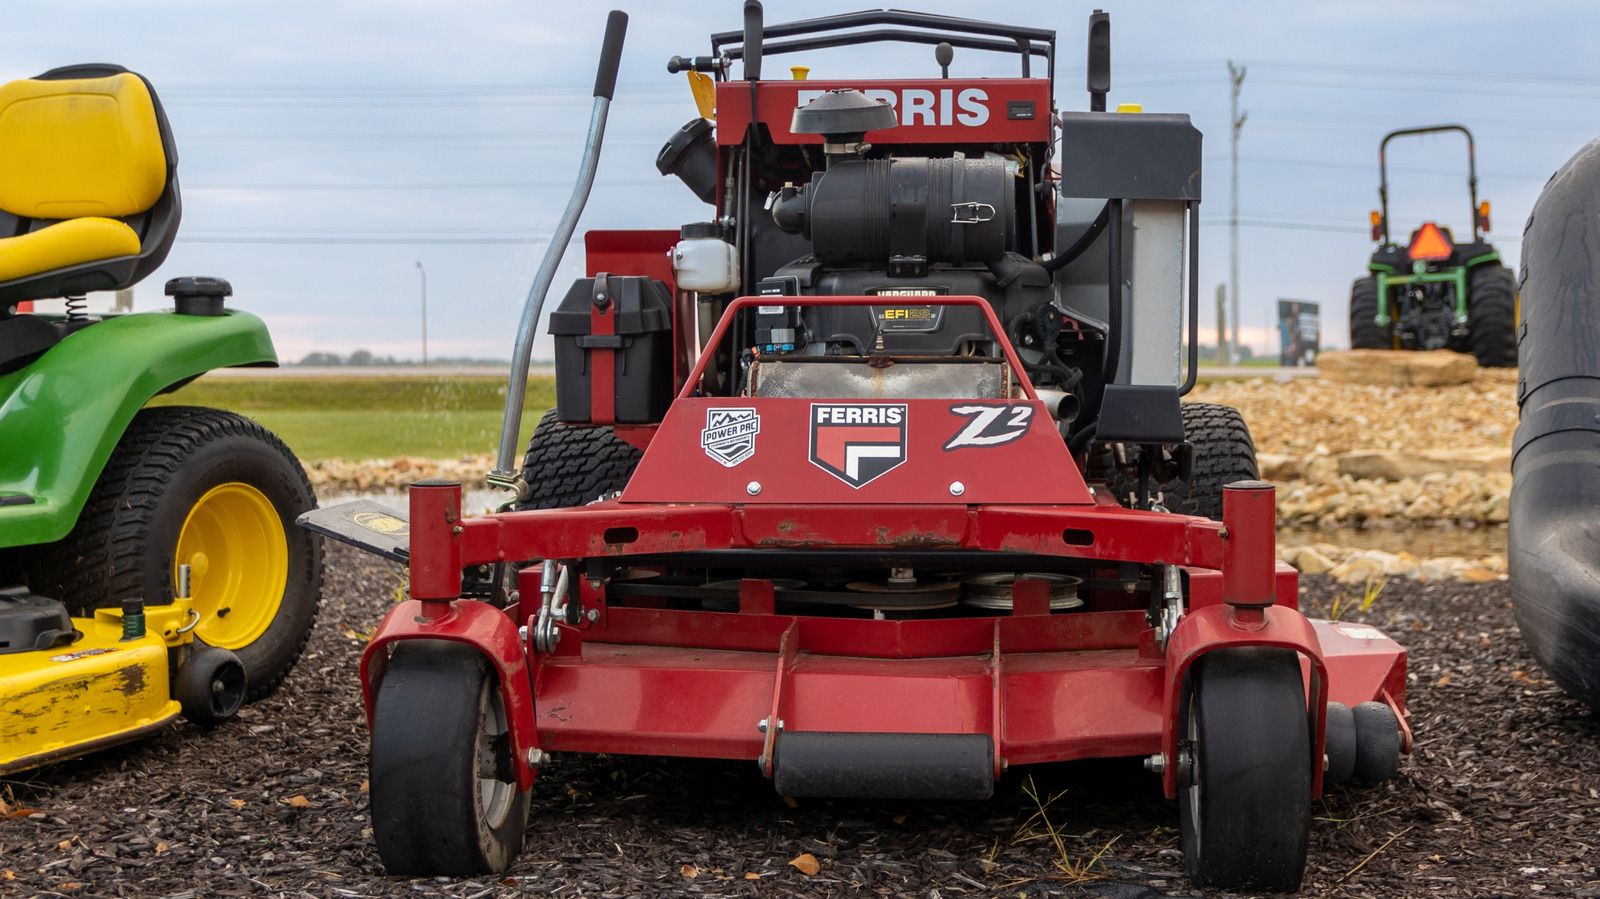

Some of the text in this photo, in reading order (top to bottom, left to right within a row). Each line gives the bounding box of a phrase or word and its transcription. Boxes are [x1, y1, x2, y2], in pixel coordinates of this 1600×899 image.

[797, 88, 990, 127] RIS
[817, 407, 902, 424] FERRIS
[706, 421, 756, 441] POWER PAC
